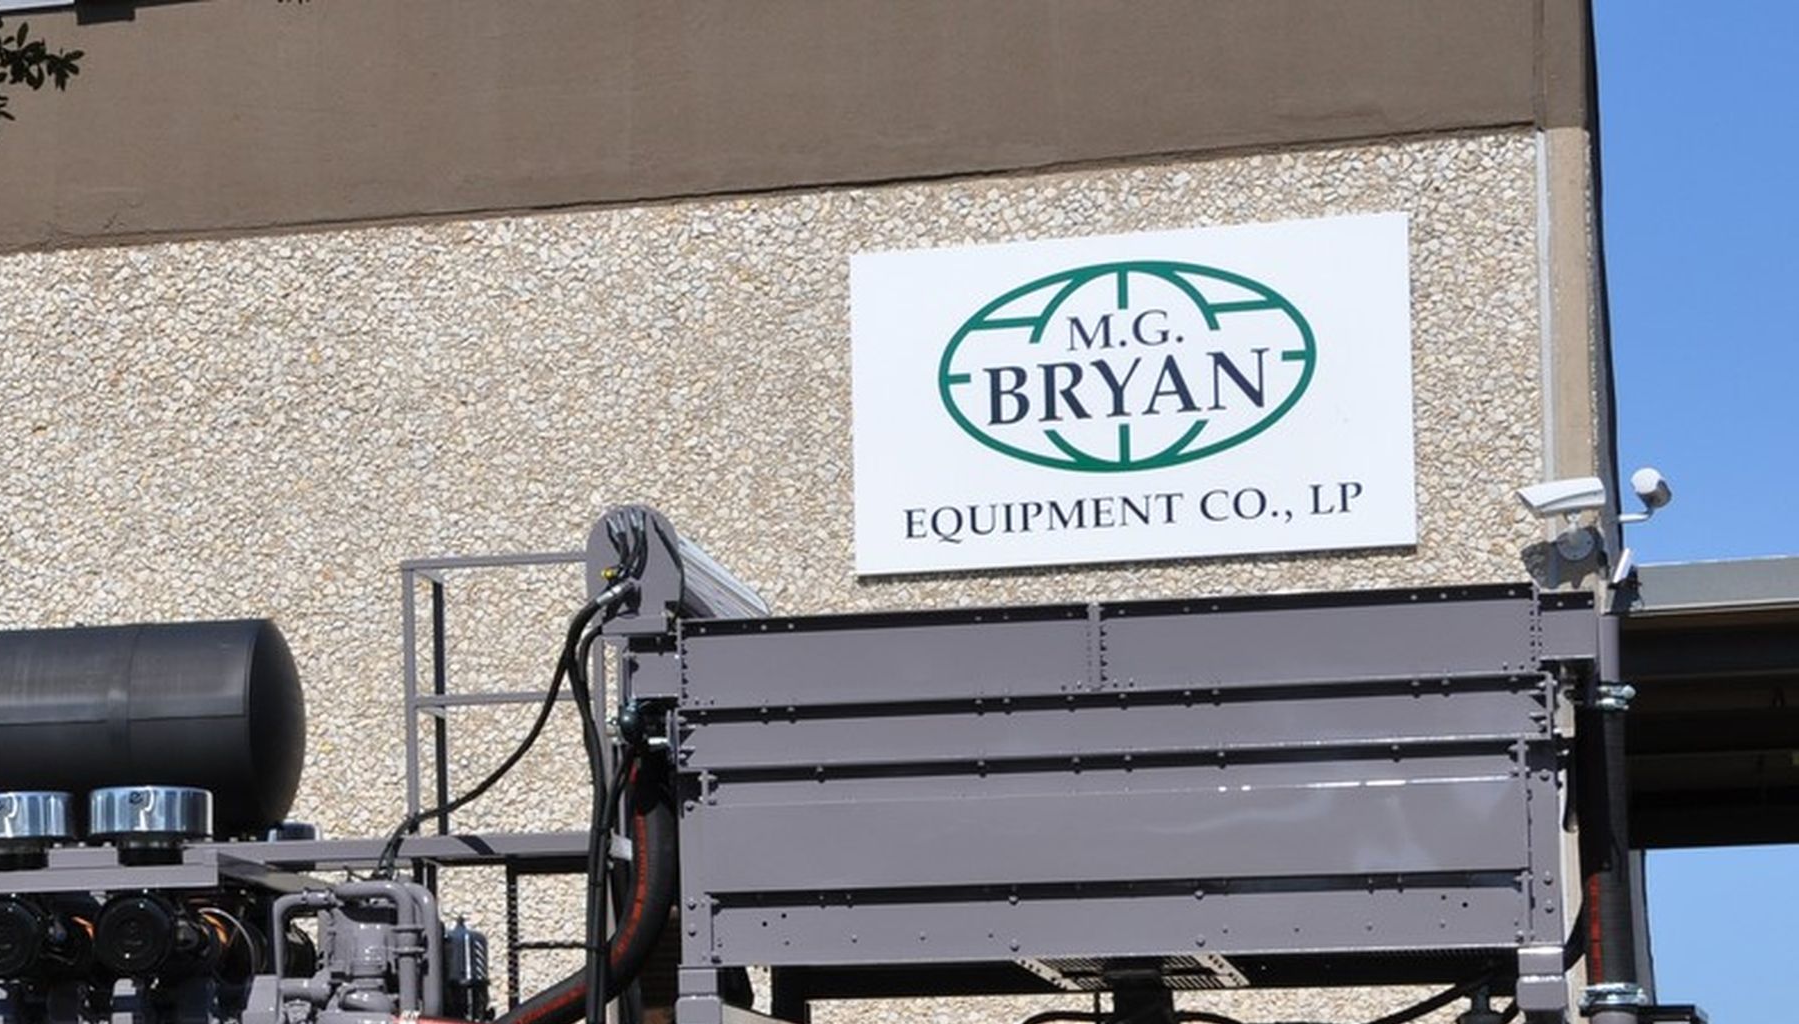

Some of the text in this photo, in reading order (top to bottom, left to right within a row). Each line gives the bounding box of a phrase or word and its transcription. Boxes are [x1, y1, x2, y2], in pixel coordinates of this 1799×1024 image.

[1067, 309, 1185, 351] M.G.
[982, 347, 1270, 426] BRYAN
[903, 481, 1362, 544] EQUIPMENT CO., LP
